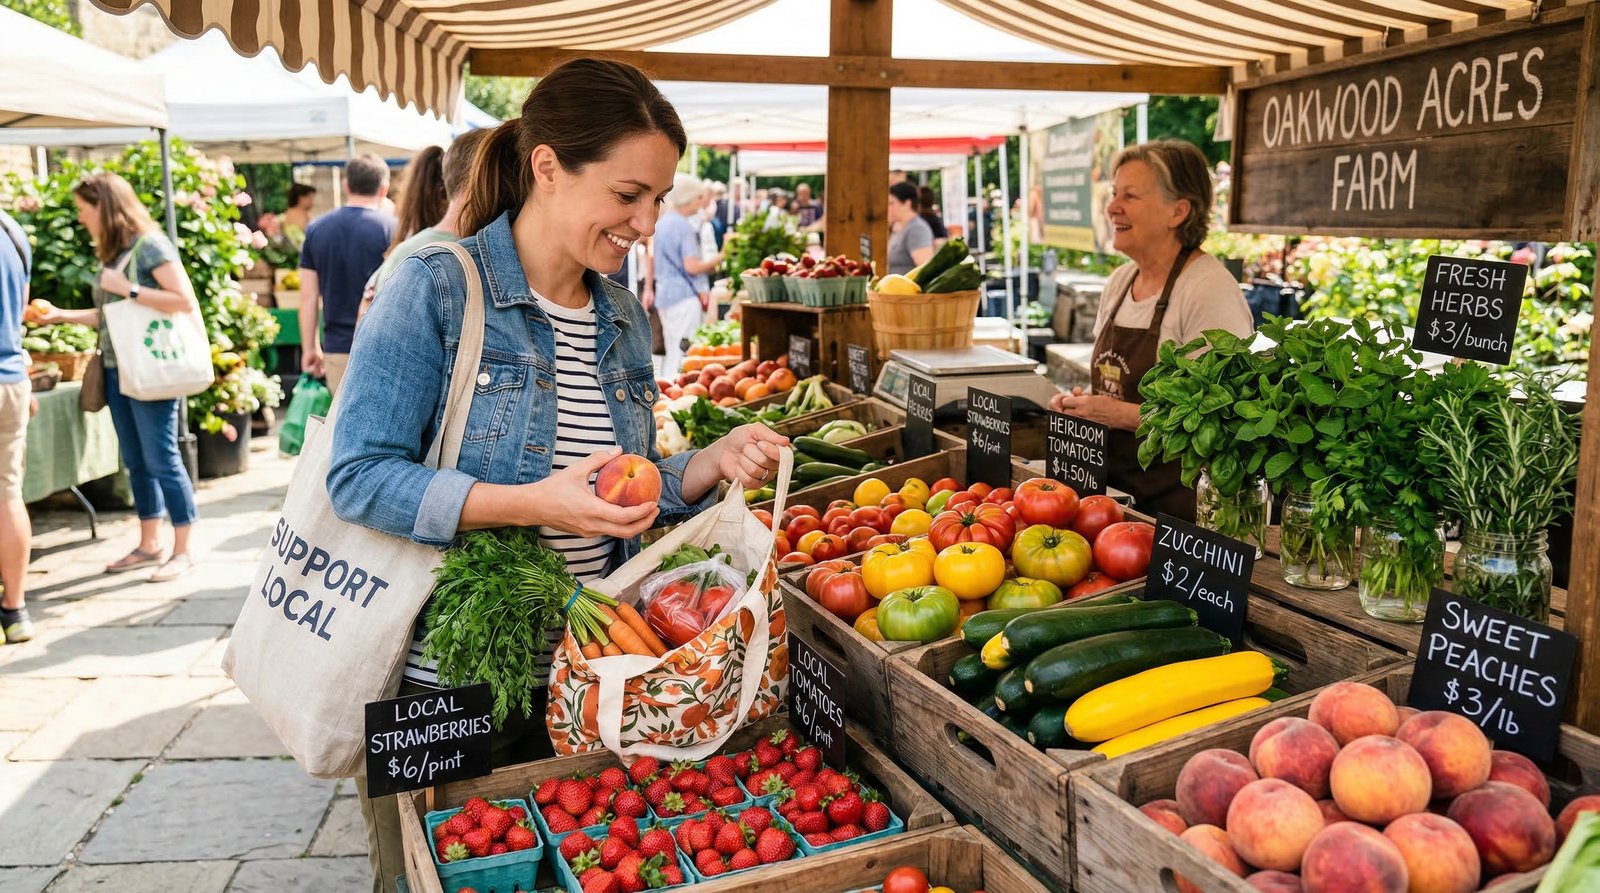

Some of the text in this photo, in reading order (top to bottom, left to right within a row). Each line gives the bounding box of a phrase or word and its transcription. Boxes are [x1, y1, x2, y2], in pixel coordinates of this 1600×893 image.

[1262, 46, 1545, 149] OAKWOOD ACRES
[1331, 149, 1418, 211] FARM
[1435, 262, 1507, 291] FRESH
[1431, 290, 1504, 320] HERBS
[1427, 318, 1508, 353] $3/bunch
[972, 393, 1001, 414] LOCAL
[971, 428, 1001, 455] $6/pint
[1047, 435, 1104, 467] TOMATOES
[1049, 414, 1104, 447] HEIRLOOM
[1052, 456, 1098, 490] $4.50/lb
[271, 516, 390, 609] SUPPORT
[1158, 524, 1244, 577] ZUCCHINI
[261, 564, 337, 642] LOCAL
[1161, 558, 1234, 613] $2/each
[1441, 601, 1551, 660] SWEET
[797, 642, 832, 690] LOCAL
[1427, 632, 1558, 708] PEACHES
[395, 695, 465, 722] LOCAL
[789, 663, 844, 729] TOMATOES
[1443, 677, 1520, 735] $3/lb
[370, 714, 492, 754] STRAWBERRIES
[795, 692, 834, 750] $6/pint
[387, 750, 466, 783] $6/pint
